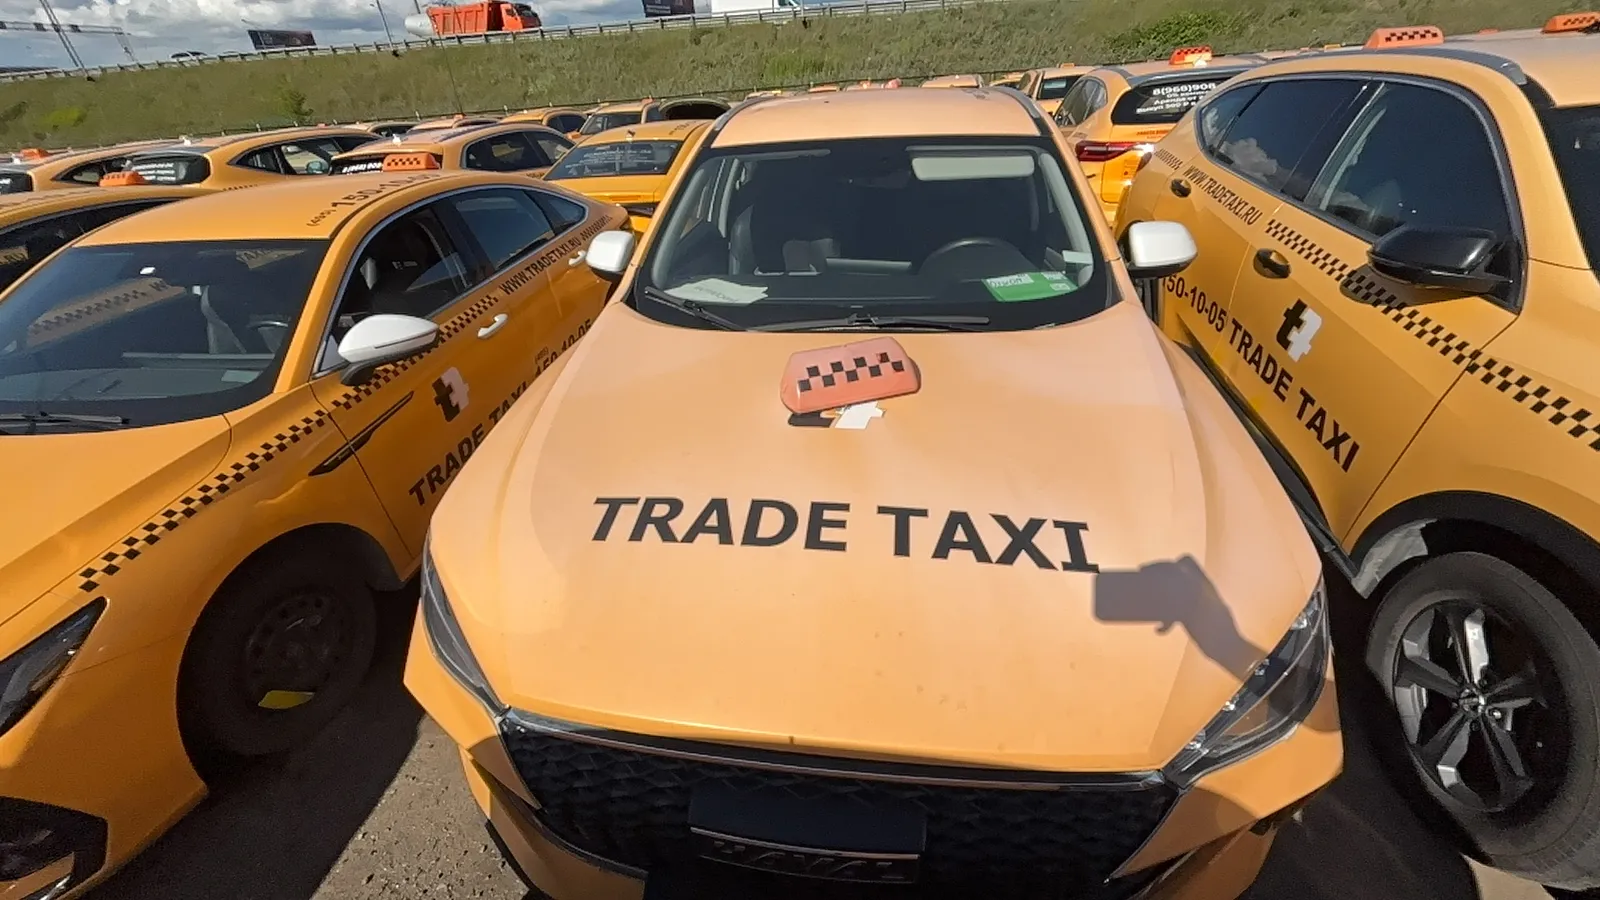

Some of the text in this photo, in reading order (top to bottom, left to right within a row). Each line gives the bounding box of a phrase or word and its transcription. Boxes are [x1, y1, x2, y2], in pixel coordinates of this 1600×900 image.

[1183, 165, 1263, 226] WWW.TRADETAXI.RU
[499, 236, 582, 296] WWW.TRADETAXI.RU
[1228, 318, 1294, 402] TRADE
[1296, 387, 1360, 473] TAXI
[408, 424, 486, 506] TRADE
[592, 496, 1101, 574] TRADE TAXI
